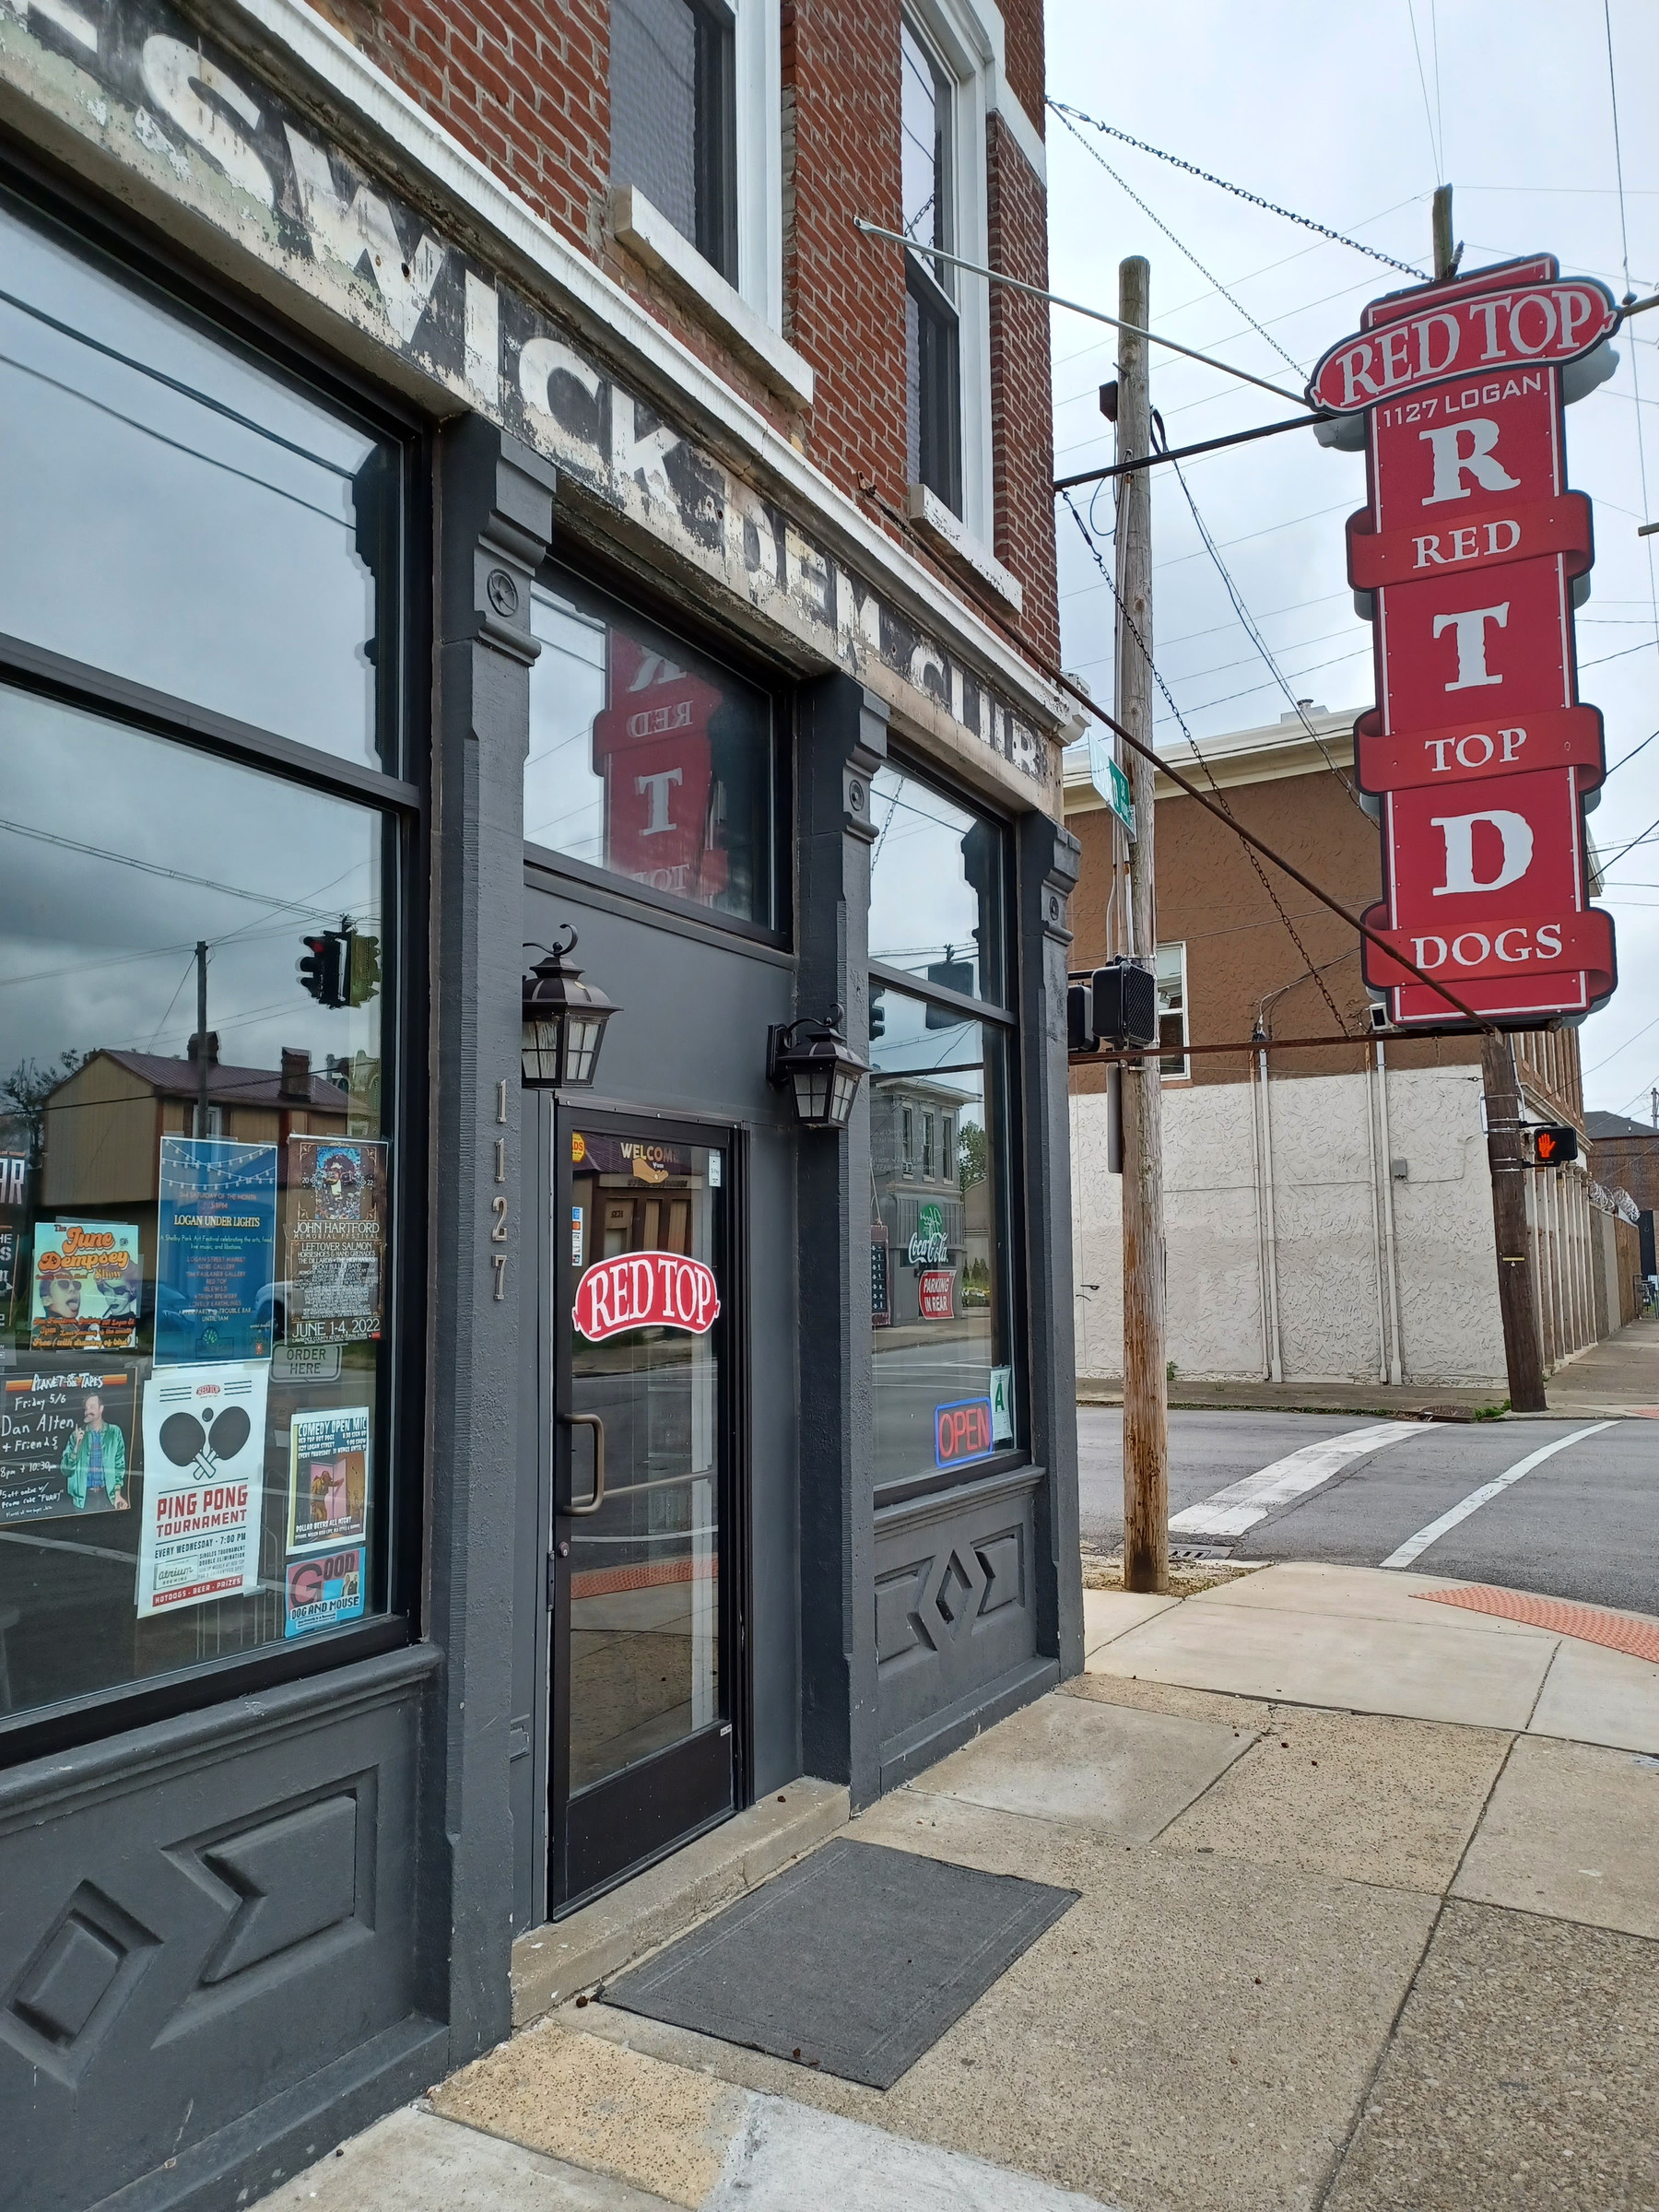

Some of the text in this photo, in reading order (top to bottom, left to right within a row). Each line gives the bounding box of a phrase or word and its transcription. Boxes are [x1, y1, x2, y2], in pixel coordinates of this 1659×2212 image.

[1335, 290, 1592, 407] RED TOP
[1383, 371, 1541, 428] 1127 LOGAN
[1418, 418, 1521, 506] R
[1411, 519, 1522, 570] RED
[1432, 601, 1511, 693] T
[1425, 727, 1526, 772] TOP
[1430, 809, 1534, 897] D
[1410, 924, 1563, 970] DOGS
[572, 1141, 583, 1151] DS
[620, 1142, 680, 1163] WELCOME
[174, 1215, 261, 1228] LOGAN UNDER LIGHTS
[293, 1222, 380, 1234] JOHN HARTFORD
[62, 1226, 115, 1256] June
[165, 1234, 181, 1243] Shelby
[220, 1235, 243, 1244] celebrating
[301, 1242, 372, 1251] LEFTOVER SALMON
[38, 1250, 130, 1274] Dempsey
[587, 1258, 712, 1335] RED TOP
[924, 1277, 949, 1294] PARKING
[924, 1296, 947, 1312] IN REAR
[291, 1322, 326, 1338] JUNE
[352, 1318, 381, 1334] 2022
[287, 1348, 326, 1360] ORDER
[289, 1362, 321, 1375] HERE
[31, 1372, 104, 1392] PLANET TAPES
[15, 1393, 66, 1411] Friday 5/6
[994, 1382, 1006, 1413] A
[1, 1413, 75, 1437] Dan Alten
[298, 1416, 368, 1437] COMEDY OPEN MIC
[938, 1406, 991, 1458] OPEN
[14, 1436, 58, 1453] Friends
[298, 1452, 311, 1460] EVERY
[311, 1449, 332, 1458] THURSDAY
[0, 1461, 57, 1479] 8pm 10:30pm
[157, 1484, 248, 1522] PING PONG
[156, 1509, 247, 1538] TOURNAMENT
[295, 1523, 313, 1534] DOLLAR
[313, 1521, 329, 1530] BEERS
[329, 1518, 337, 1526] ALL
[337, 1515, 352, 1525] NIGHT
[155, 1532, 246, 1559] EVERY WEDNESDAY 7:00 PM
[199, 1545, 245, 1559] SINGLES TOURNAMENT
[199, 1558, 216, 1567] DOUBLE
[217, 1552, 245, 1562] ELIMINATION
[155, 1578, 241, 1604] HOTDOGS BEER PRIZES
[290, 1552, 356, 1609] GOOD
[291, 1606, 307, 1620] DOG
[308, 1602, 328, 1616] AND
[329, 1595, 359, 1612] MOUSE
